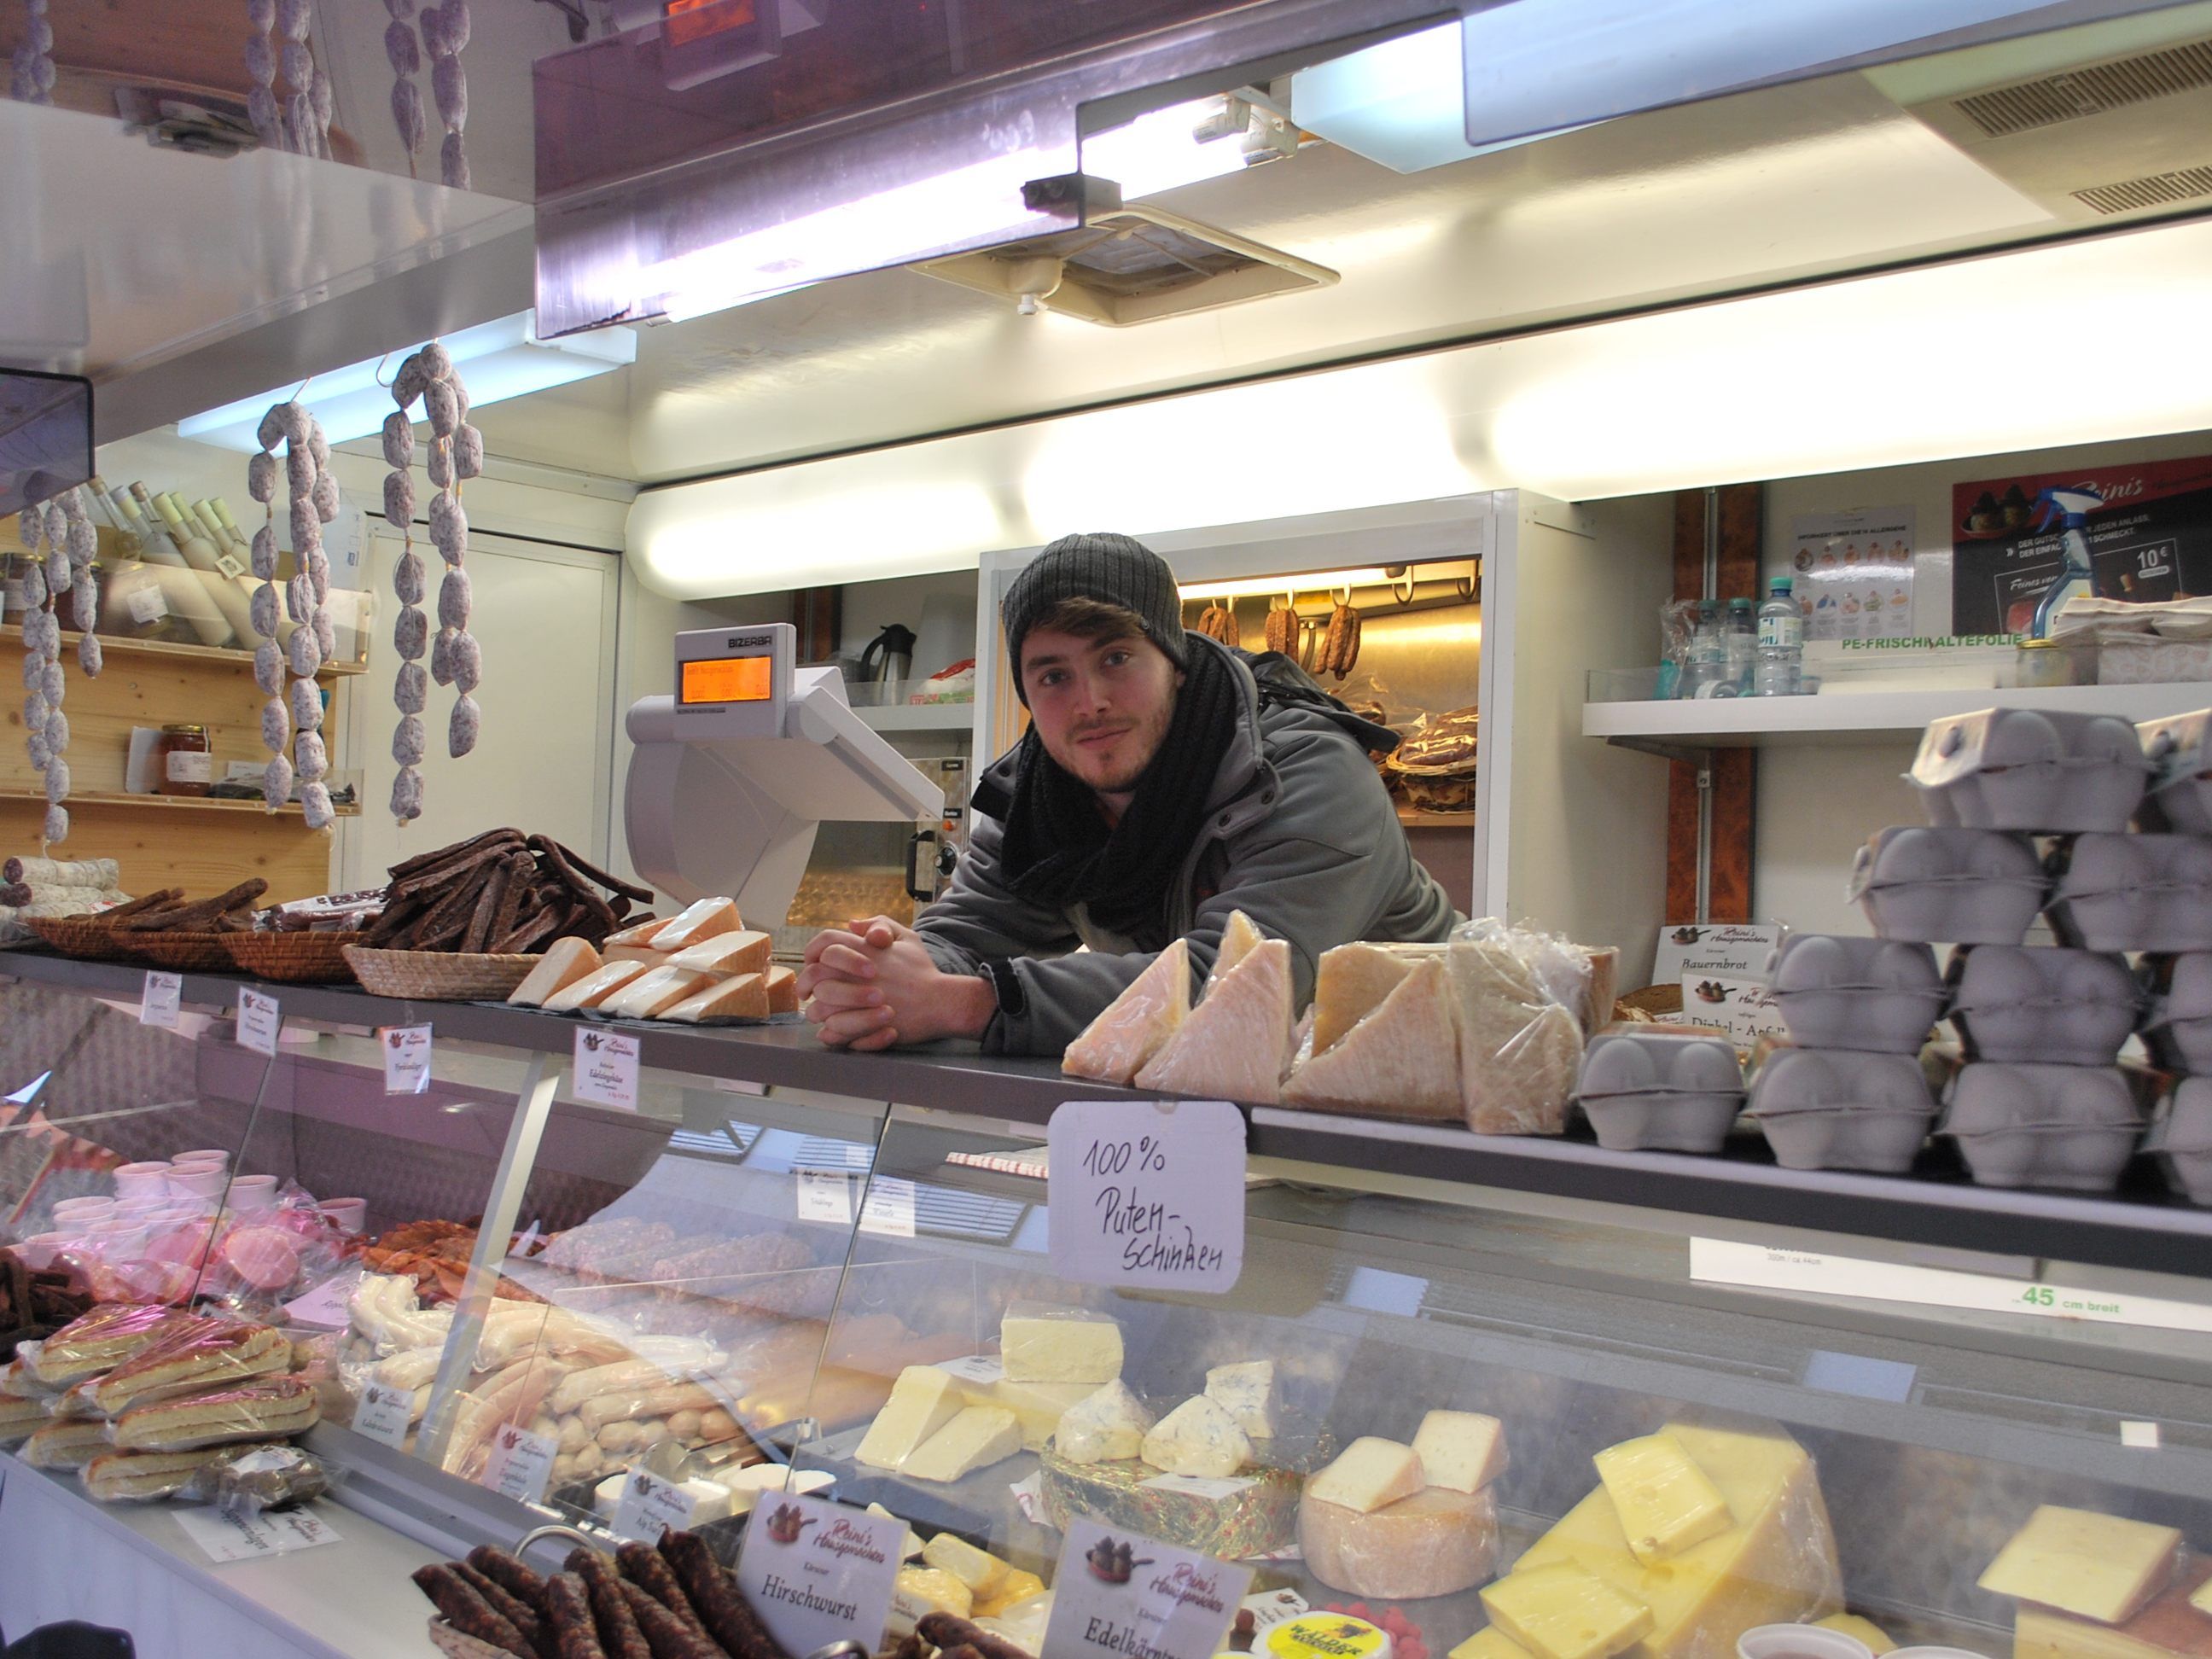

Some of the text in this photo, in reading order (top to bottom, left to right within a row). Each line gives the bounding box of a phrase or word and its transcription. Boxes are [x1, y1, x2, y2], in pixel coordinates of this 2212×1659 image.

[2019, 549, 2034, 559] DER
[2035, 543, 2062, 555] EINFAC
[2034, 534, 2059, 545] GUTSC
[728, 636, 772, 649] BIZERBA
[1682, 958, 1749, 970] Bauernbrot
[1095, 1185, 1181, 1235] Puten-
[2022, 1286, 2121, 1313] 45 cm breit
[831, 1518, 873, 1546] Reini's
[760, 1574, 857, 1621] Hirschwurst
[1083, 1615, 1183, 1659] Edelkärnt
